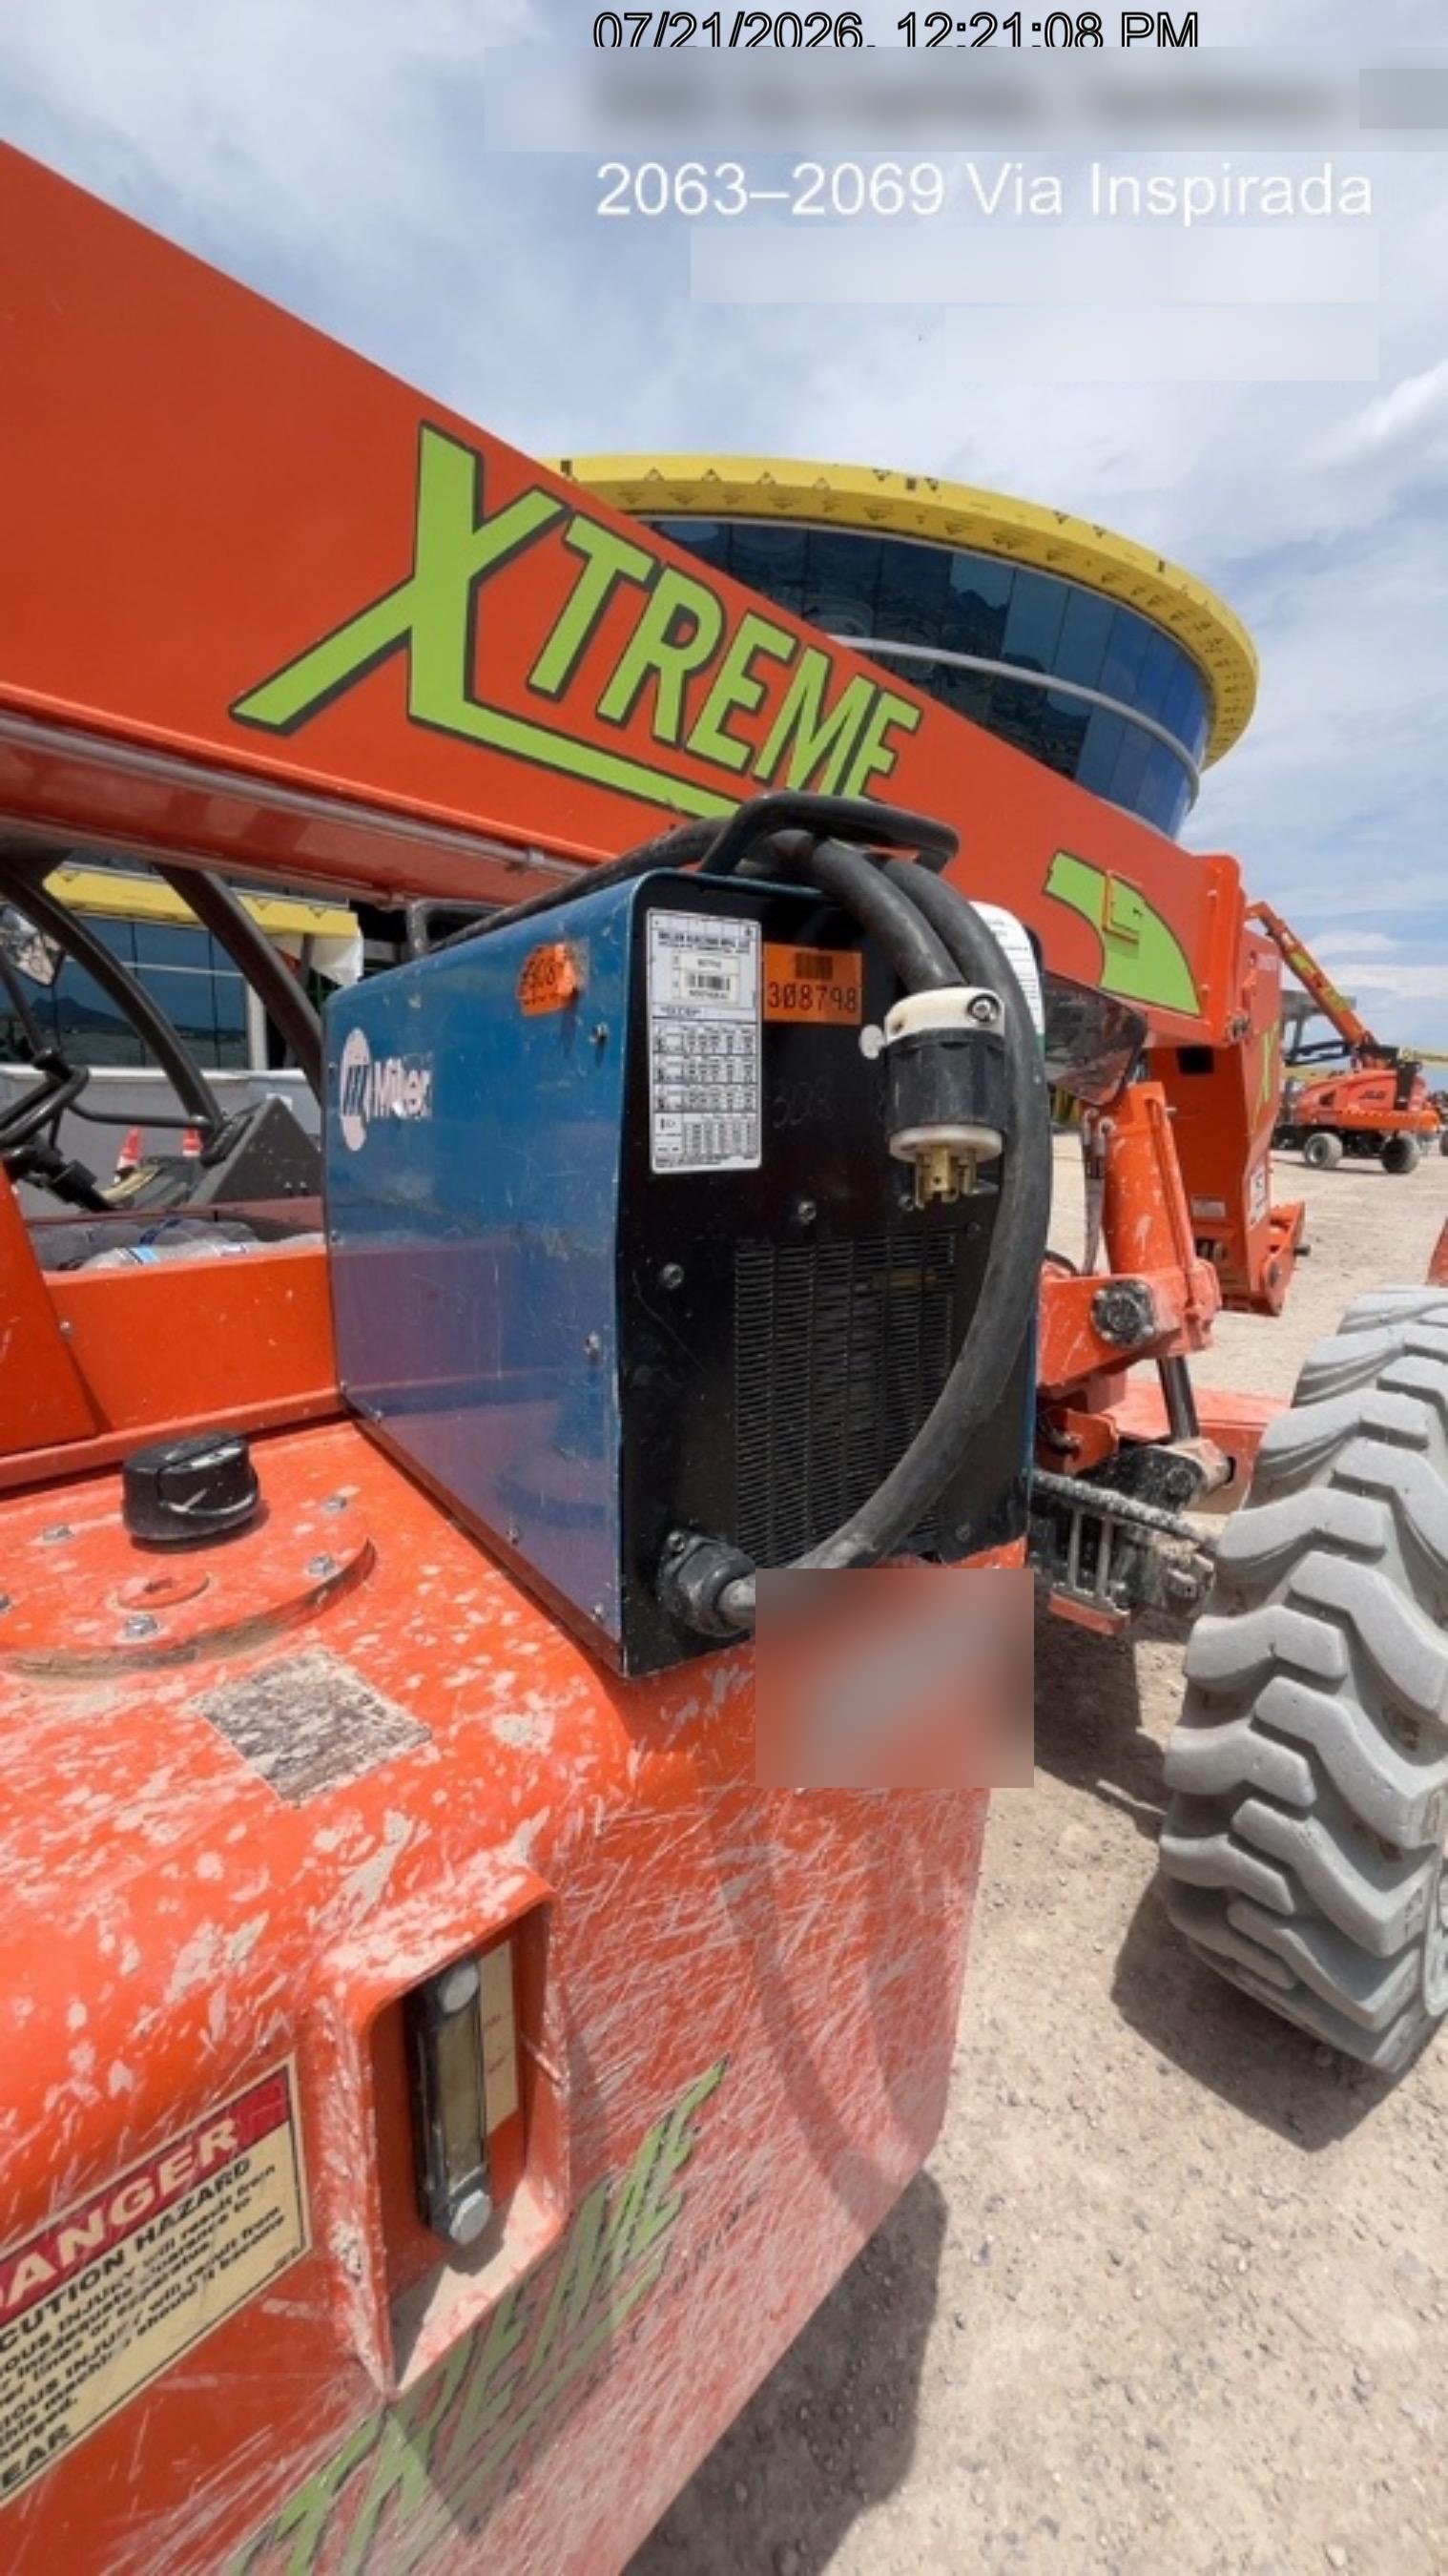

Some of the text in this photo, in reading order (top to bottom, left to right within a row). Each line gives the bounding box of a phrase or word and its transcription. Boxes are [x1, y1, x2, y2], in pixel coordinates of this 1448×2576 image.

[227, 418, 923, 822] XTREME
[768, 981, 858, 1013] 308798
[0, 2109, 238, 2315] ANGER
[135, 2152, 251, 2254] HAZARD
[0, 2327, 52, 2379] OUS
[221, 2053, 730, 2576] TREME
[0, 2375, 58, 2434] IOUS
